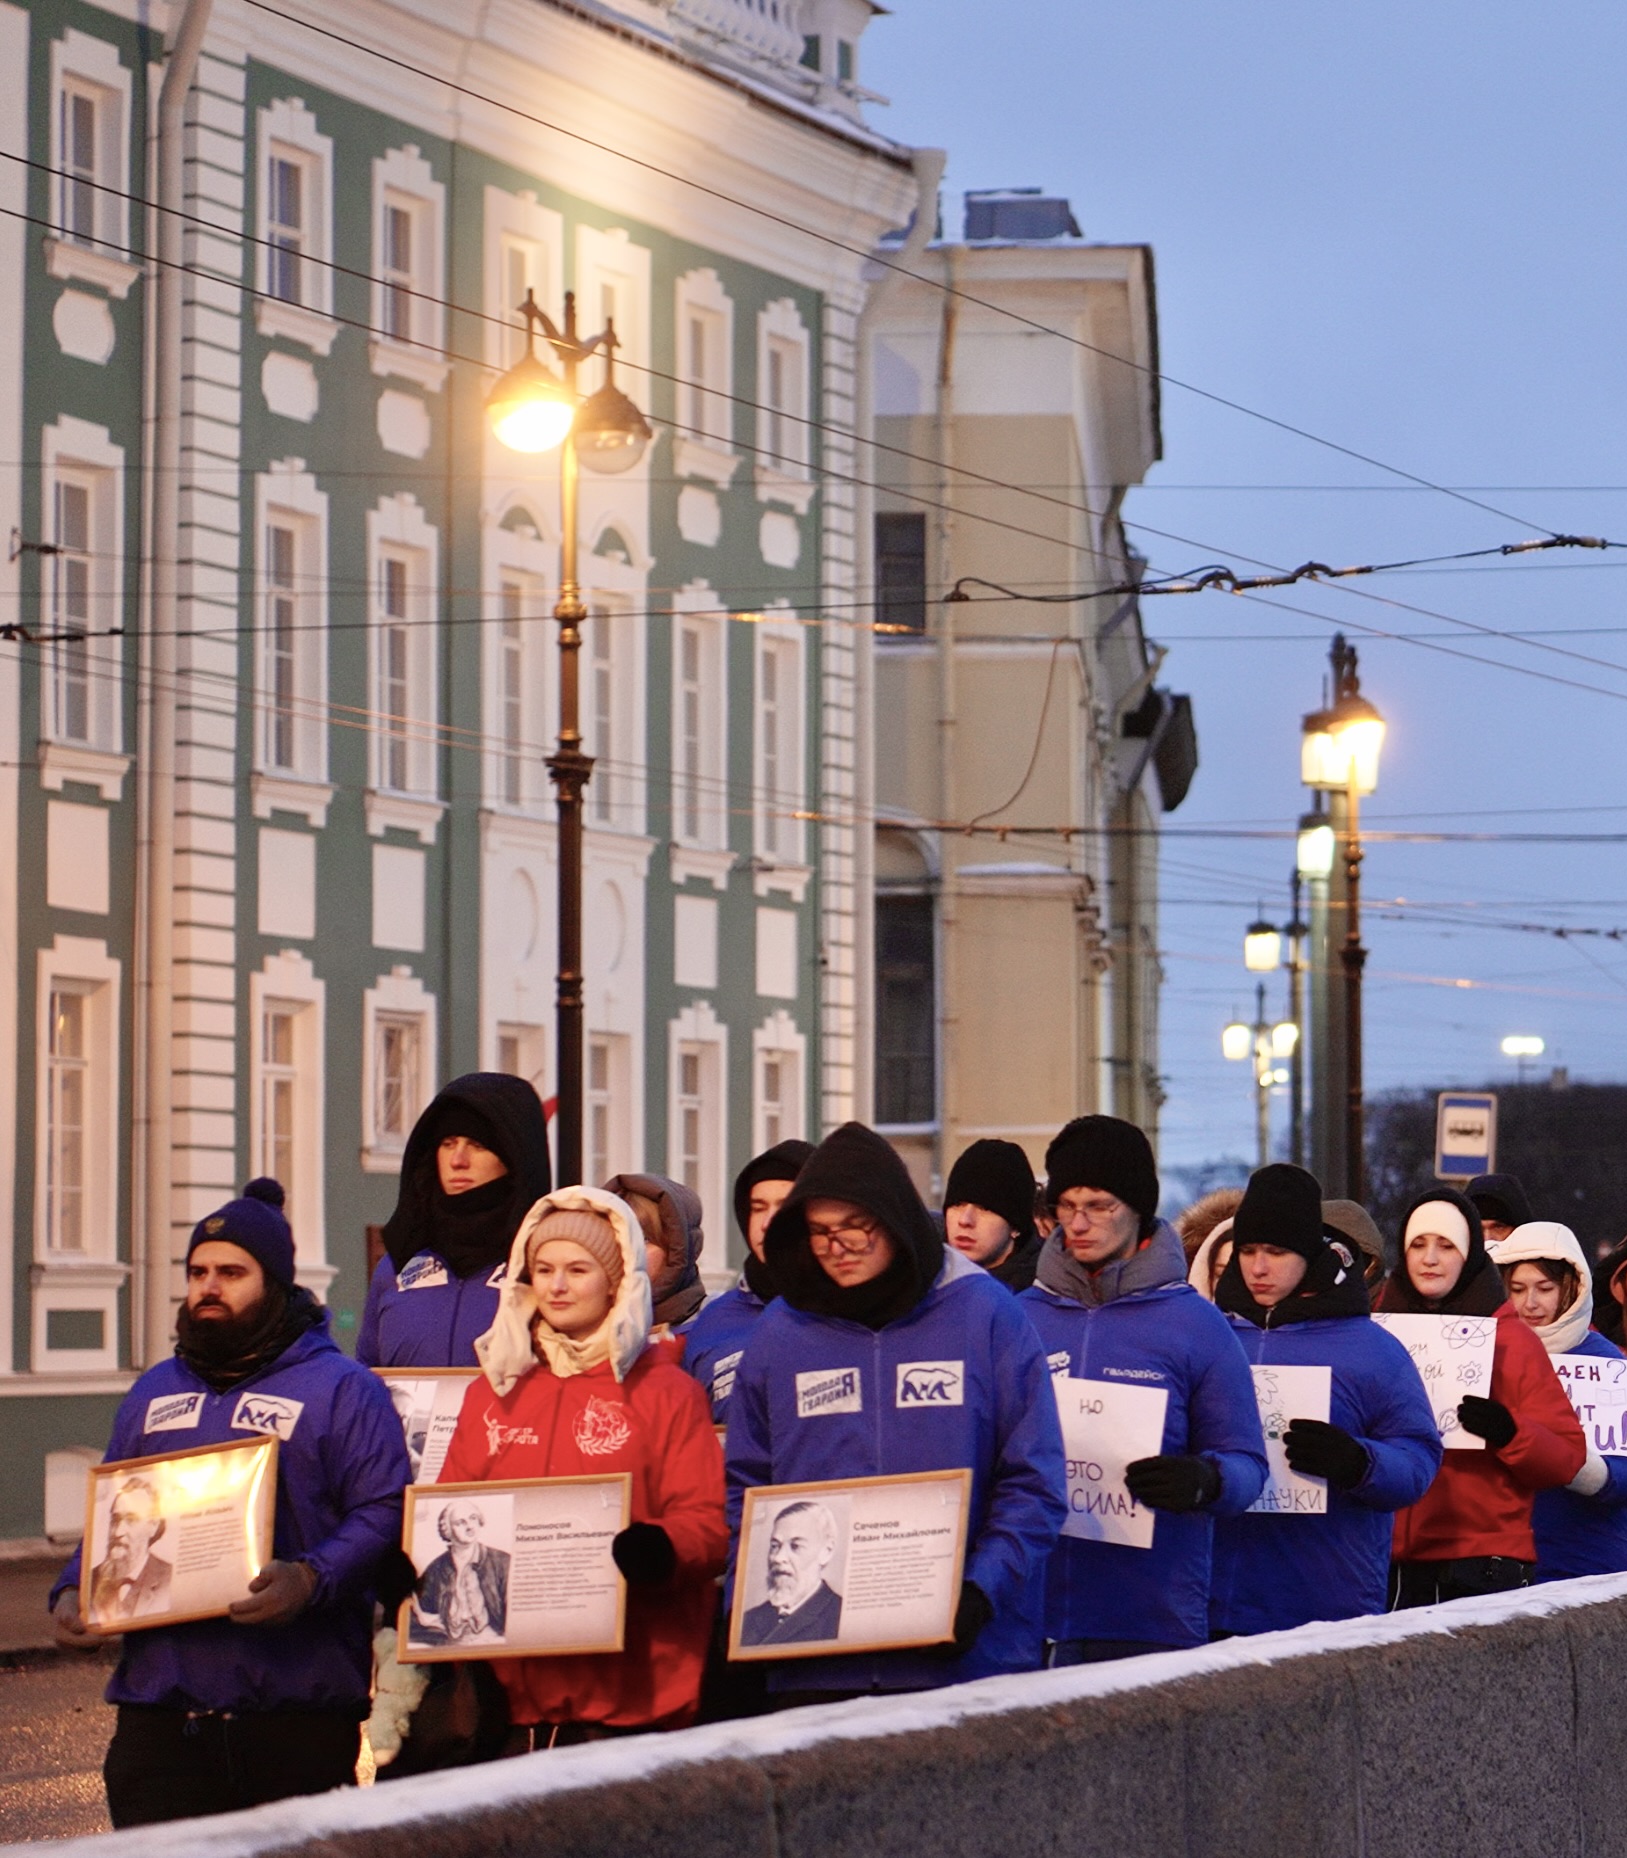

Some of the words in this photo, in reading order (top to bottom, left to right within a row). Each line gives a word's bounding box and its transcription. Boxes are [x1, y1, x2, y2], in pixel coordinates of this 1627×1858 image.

[1555, 1360, 1627, 1383] ДЕН?
[1065, 1460, 1103, 1481] ЭТО
[1071, 1488, 1136, 1518] СИЛА!
[516, 1522, 571, 1531] Ломоносов
[853, 1521, 900, 1531] Сеченов
[515, 1534, 554, 1542] Михаил
[883, 1527, 951, 1540] Михайлович
